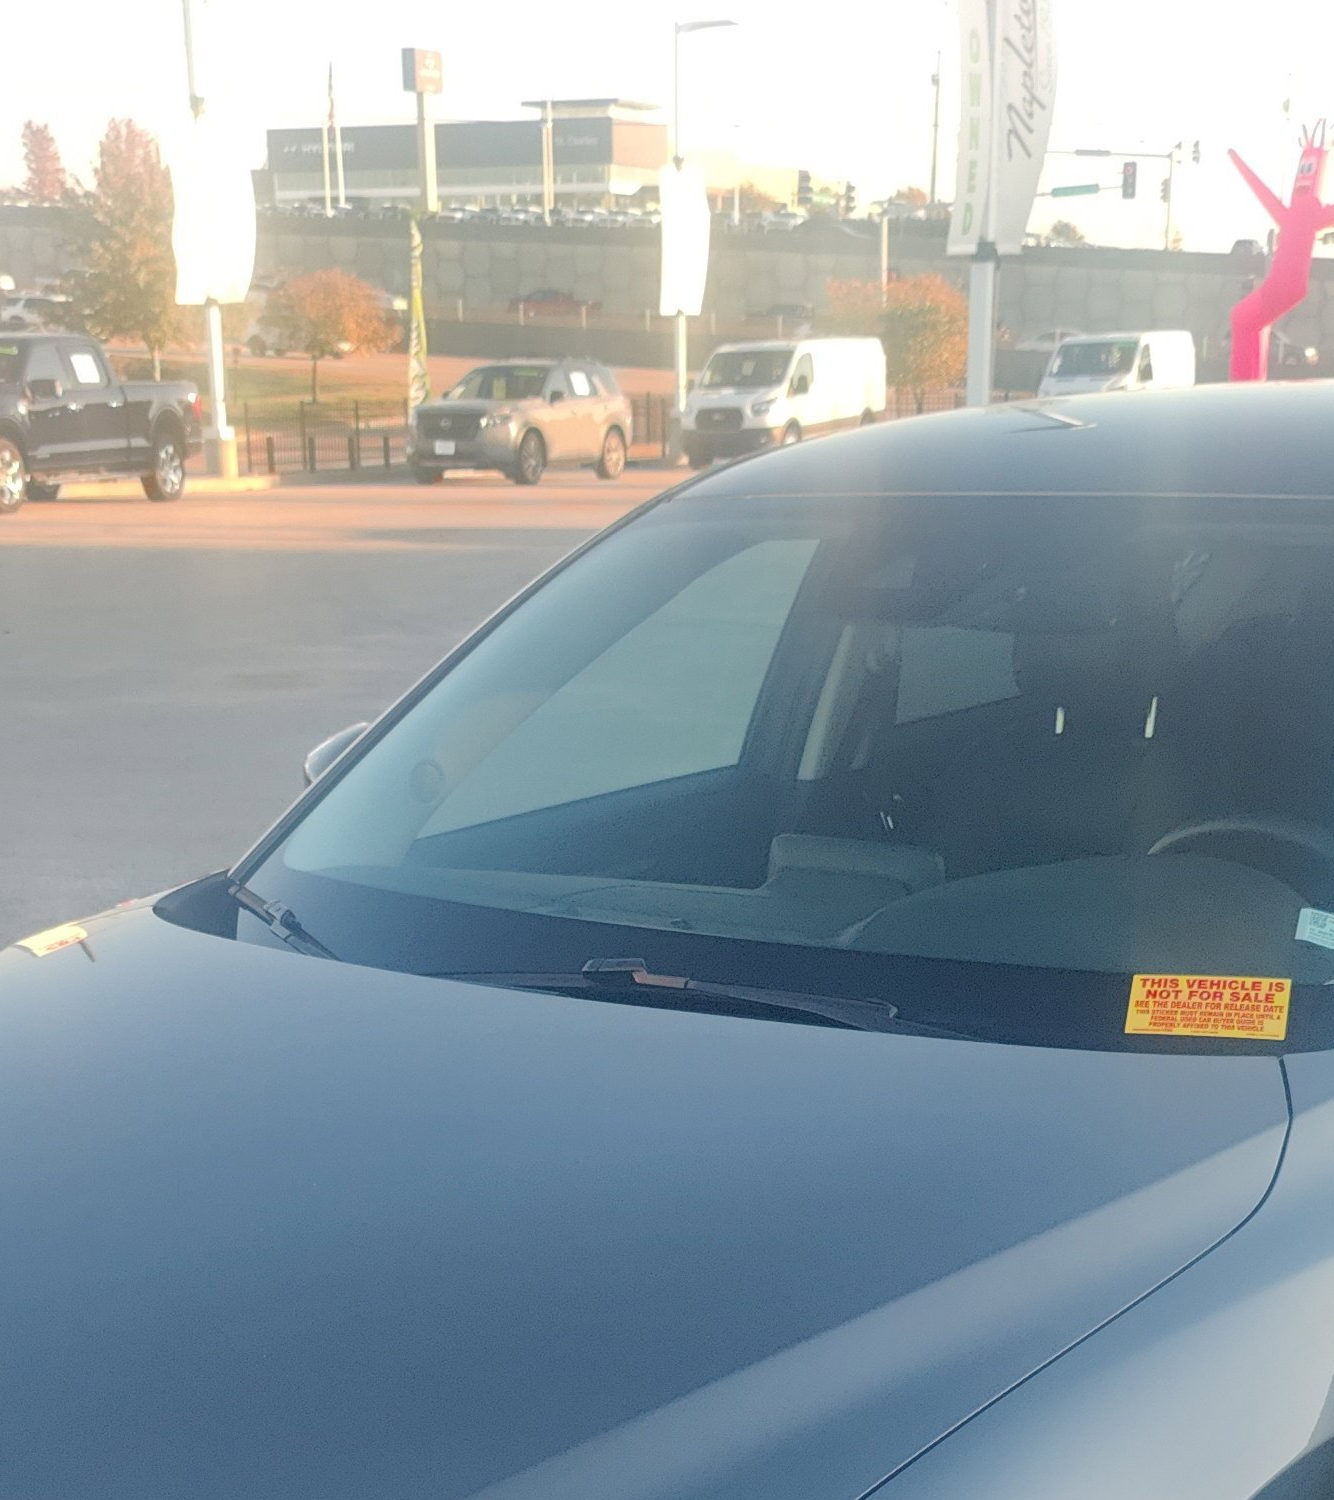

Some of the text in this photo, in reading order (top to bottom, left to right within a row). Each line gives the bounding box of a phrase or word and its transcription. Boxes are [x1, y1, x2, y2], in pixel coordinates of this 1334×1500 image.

[1140, 978, 1286, 993] THIS VEHICLE IS
[1146, 989, 1276, 1004] NOT FOR SALE
[1134, 1000, 1285, 1014] SEE THE DEALER FOR RELEASE DATE
[1256, 1013, 1274, 1021] UNTIL
